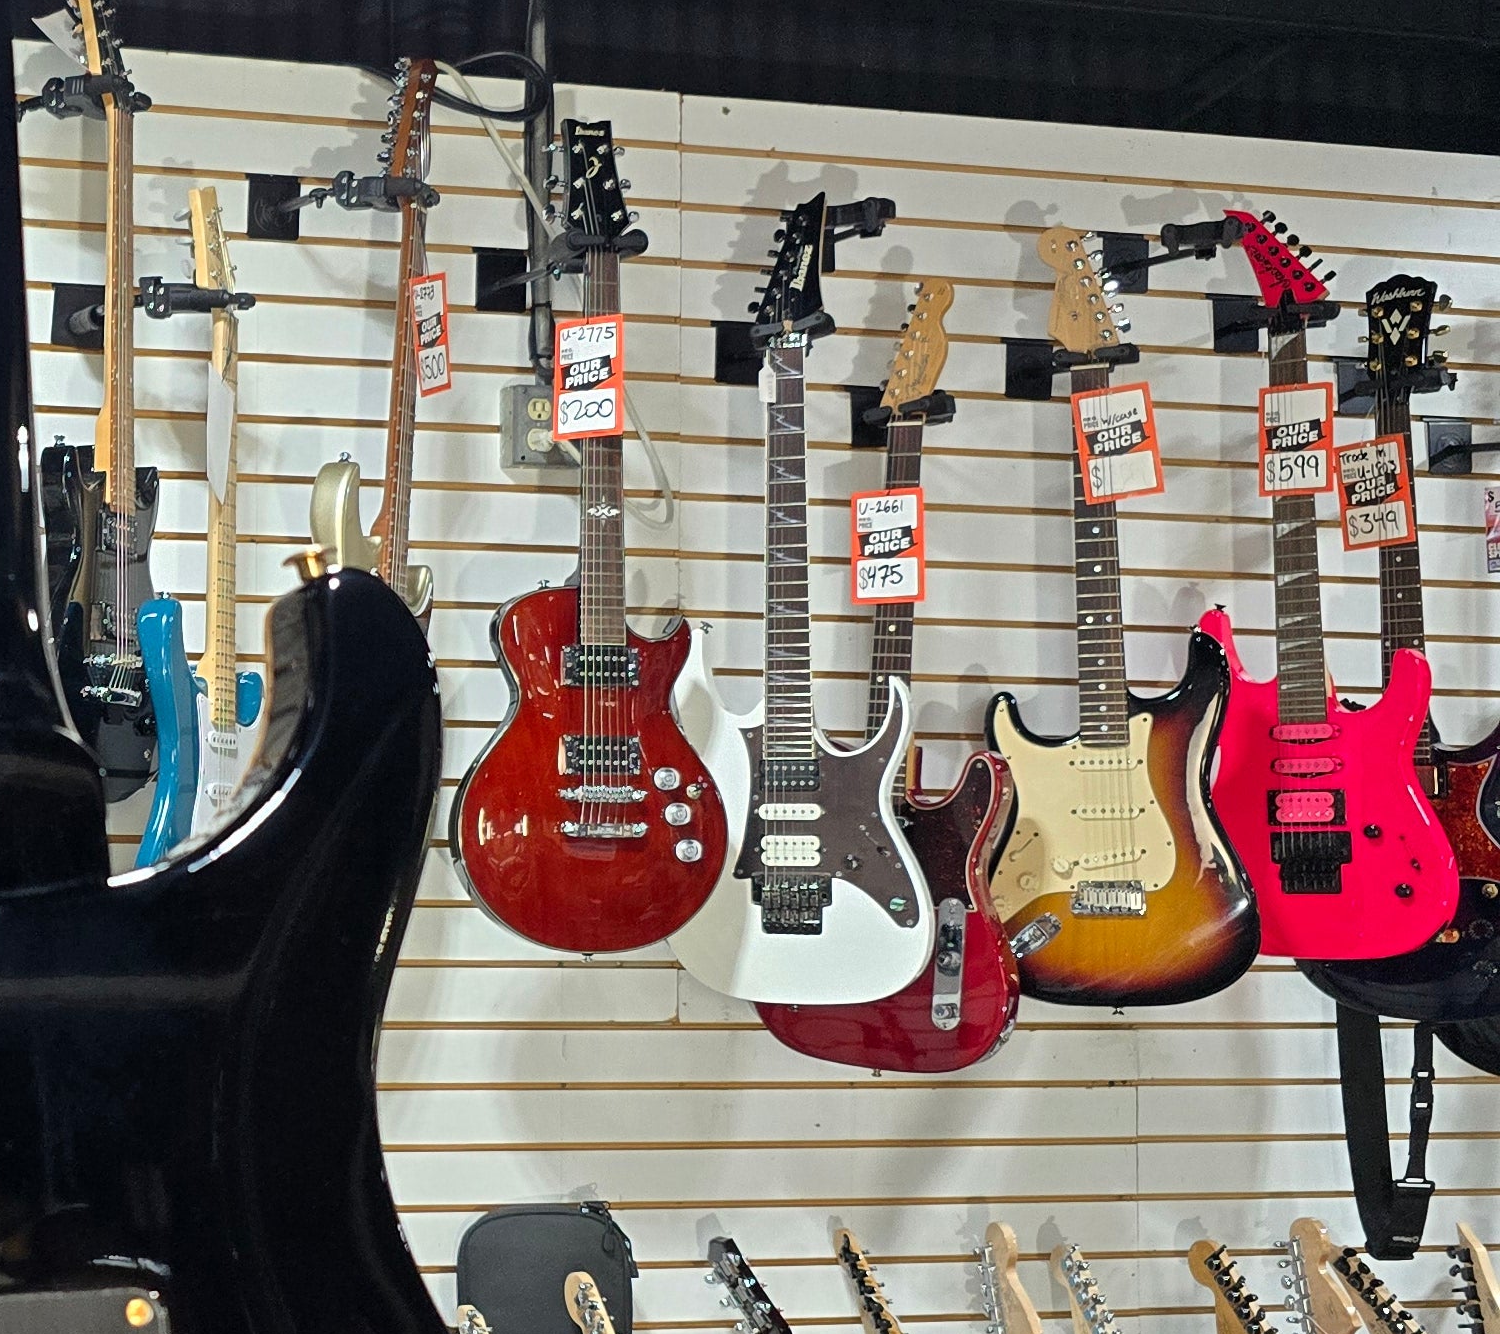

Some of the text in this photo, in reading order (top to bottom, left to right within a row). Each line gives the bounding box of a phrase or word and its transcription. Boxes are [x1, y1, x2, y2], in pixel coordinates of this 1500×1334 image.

[789, 244, 813, 292] Ibanez
[1370, 287, 1426, 306] Washburn
[420, 324, 442, 346] PRICE
[421, 317, 437, 333] OUR
[562, 325, 616, 343] U-2775
[569, 358, 601, 376] OUR
[565, 367, 610, 390] PRICE
[560, 398, 614, 426] $200
[1097, 425, 1132, 442] OUR
[1272, 430, 1319, 450] PRICE
[1276, 422, 1310, 438] OUR
[1093, 432, 1142, 455] PRICE
[1266, 455, 1319, 483] $599
[1351, 482, 1396, 505] PRICE
[1355, 476, 1387, 493] OUR
[859, 499, 904, 516] U-2661
[1349, 510, 1400, 539] $349
[864, 536, 911, 556] PRICE
[869, 528, 902, 544] OUR
[859, 564, 904, 591] $475
